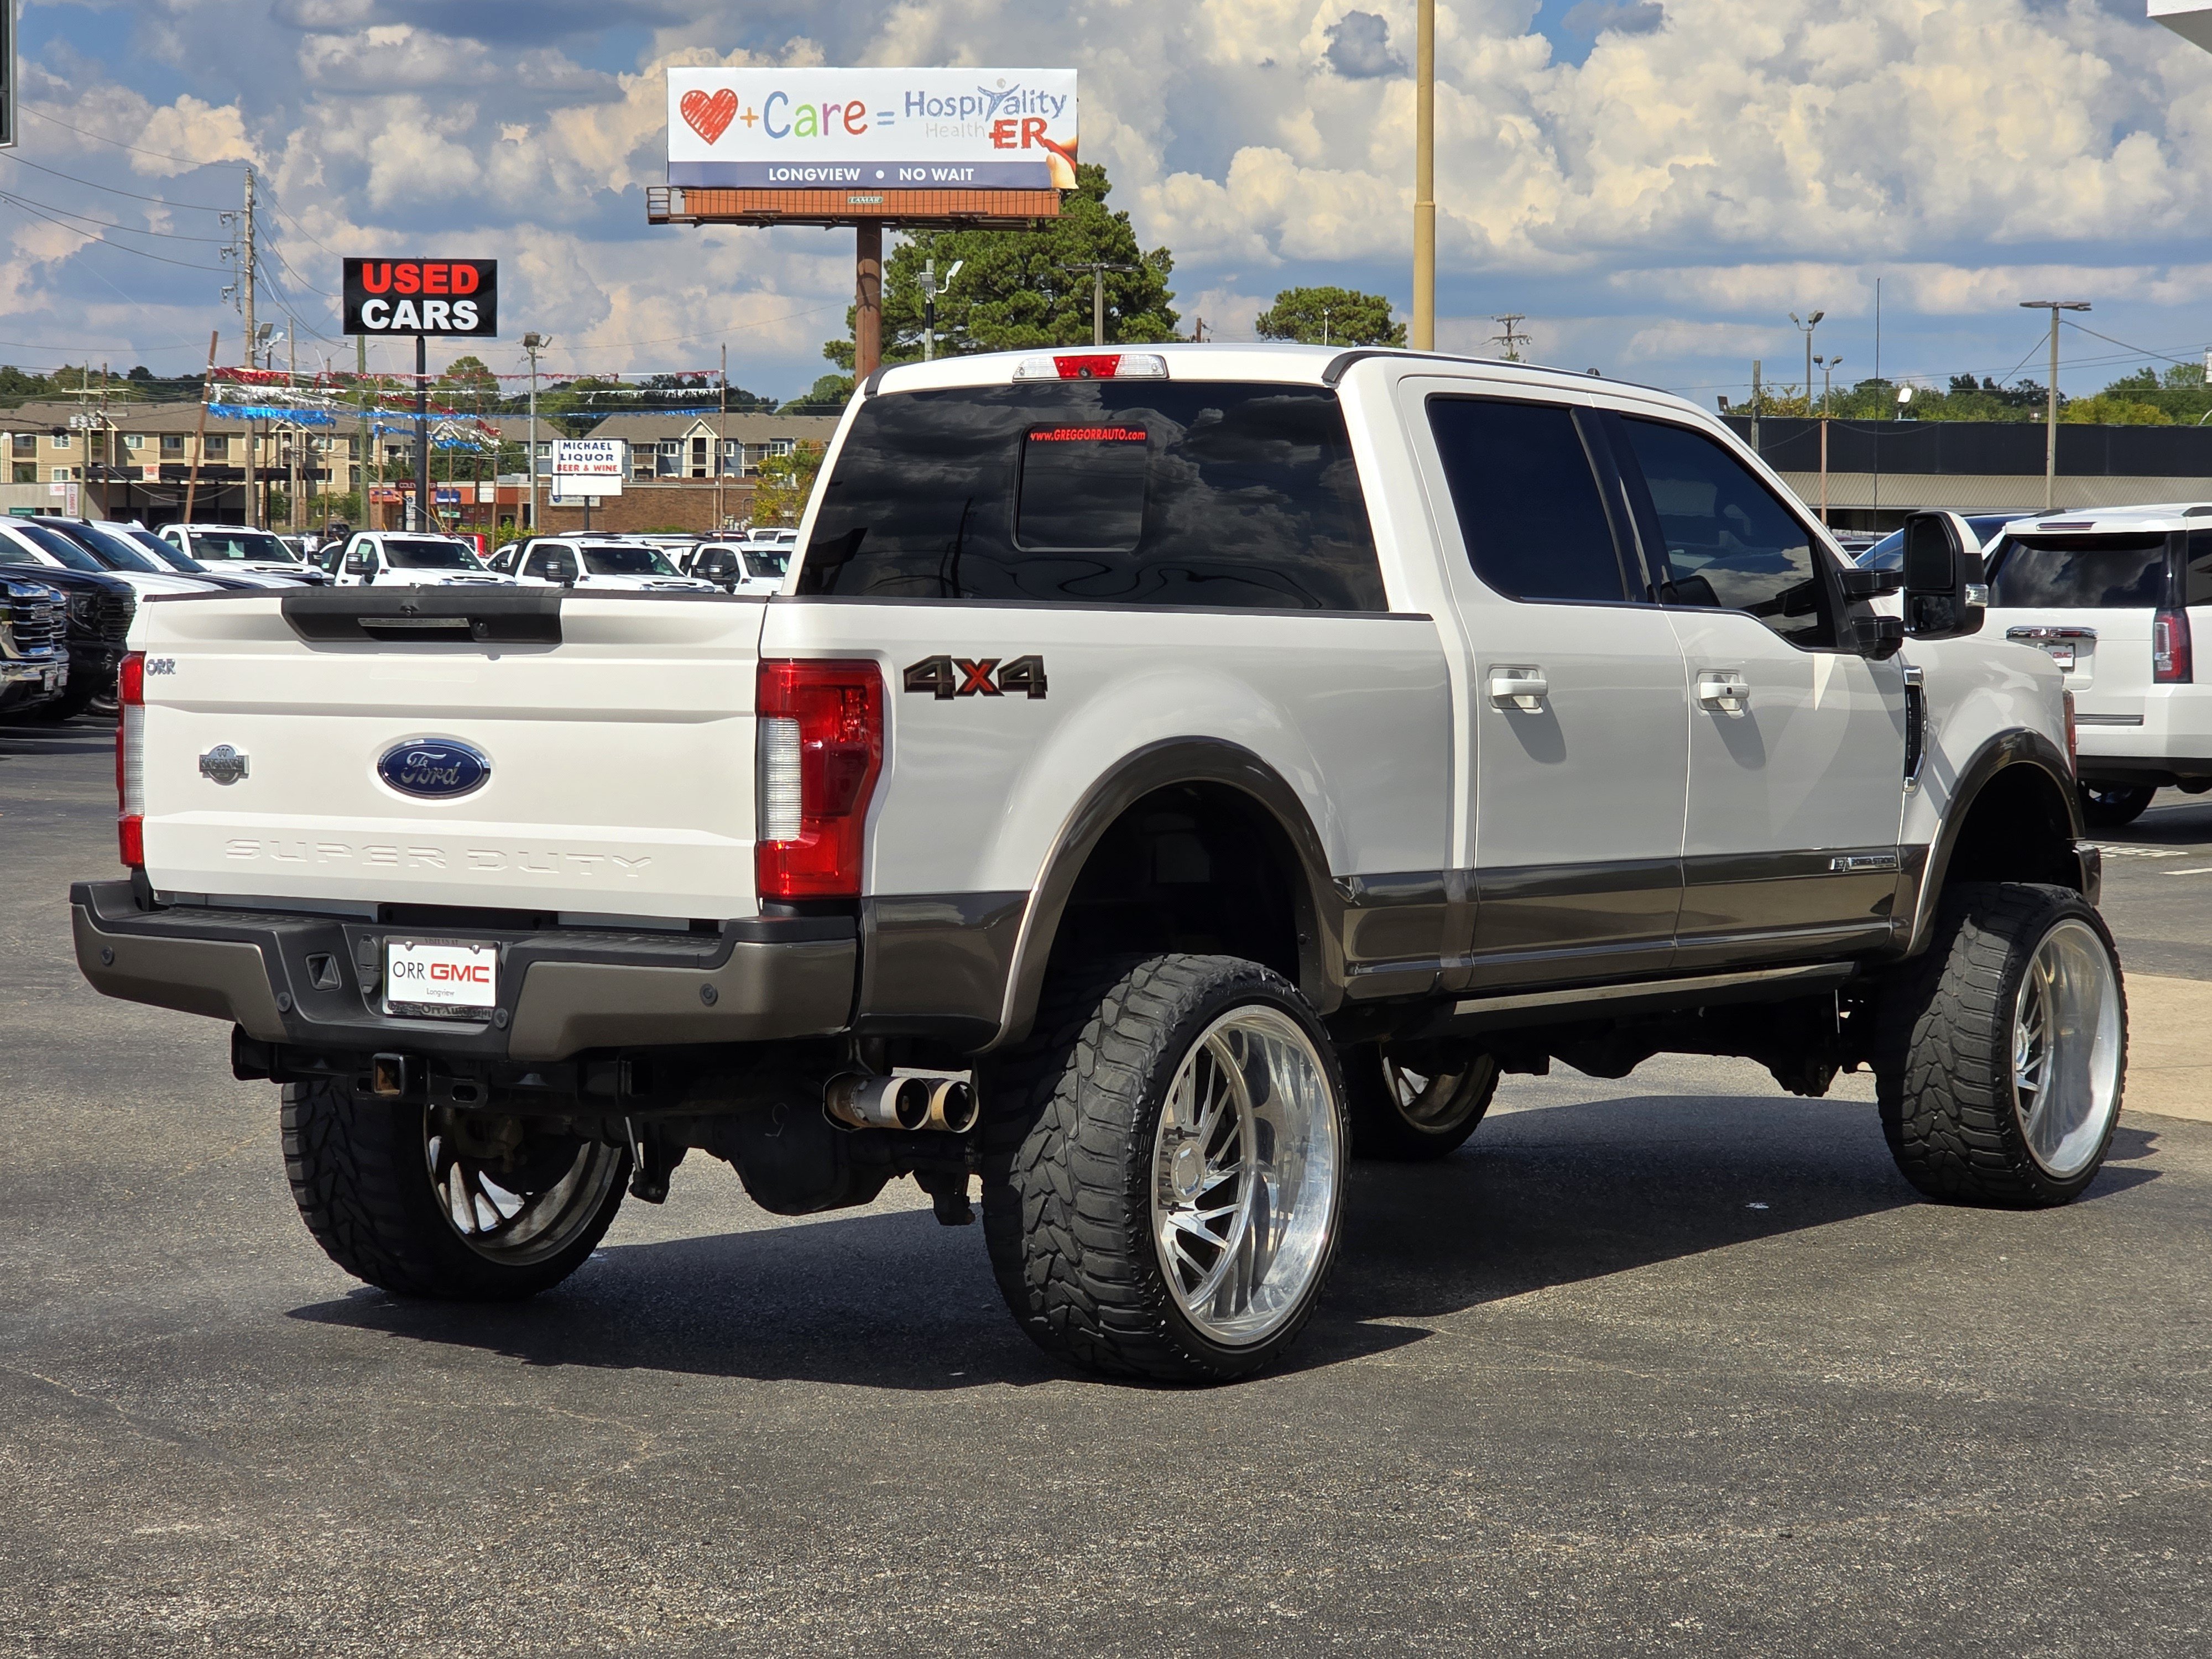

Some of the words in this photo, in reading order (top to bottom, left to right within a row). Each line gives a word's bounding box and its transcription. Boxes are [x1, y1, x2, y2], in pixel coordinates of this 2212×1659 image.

[763, 91, 868, 139] Care
[925, 121, 985, 139] Health
[989, 117, 1047, 149] ER
[768, 168, 861, 182] LONGVIEW
[899, 168, 927, 181] NO
[931, 168, 974, 181] WAIT
[362, 263, 479, 295] USED
[361, 299, 479, 330] CARS
[562, 442, 612, 451] MICHAEL
[146, 659, 176, 676] ORR
[400, 751, 461, 785] Ford
[226, 838, 447, 869] SUPER
[467, 849, 651, 877] DUTY
[393, 961, 426, 980] ORR
[430, 963, 489, 983] GMC
[426, 988, 455, 997] Longview
